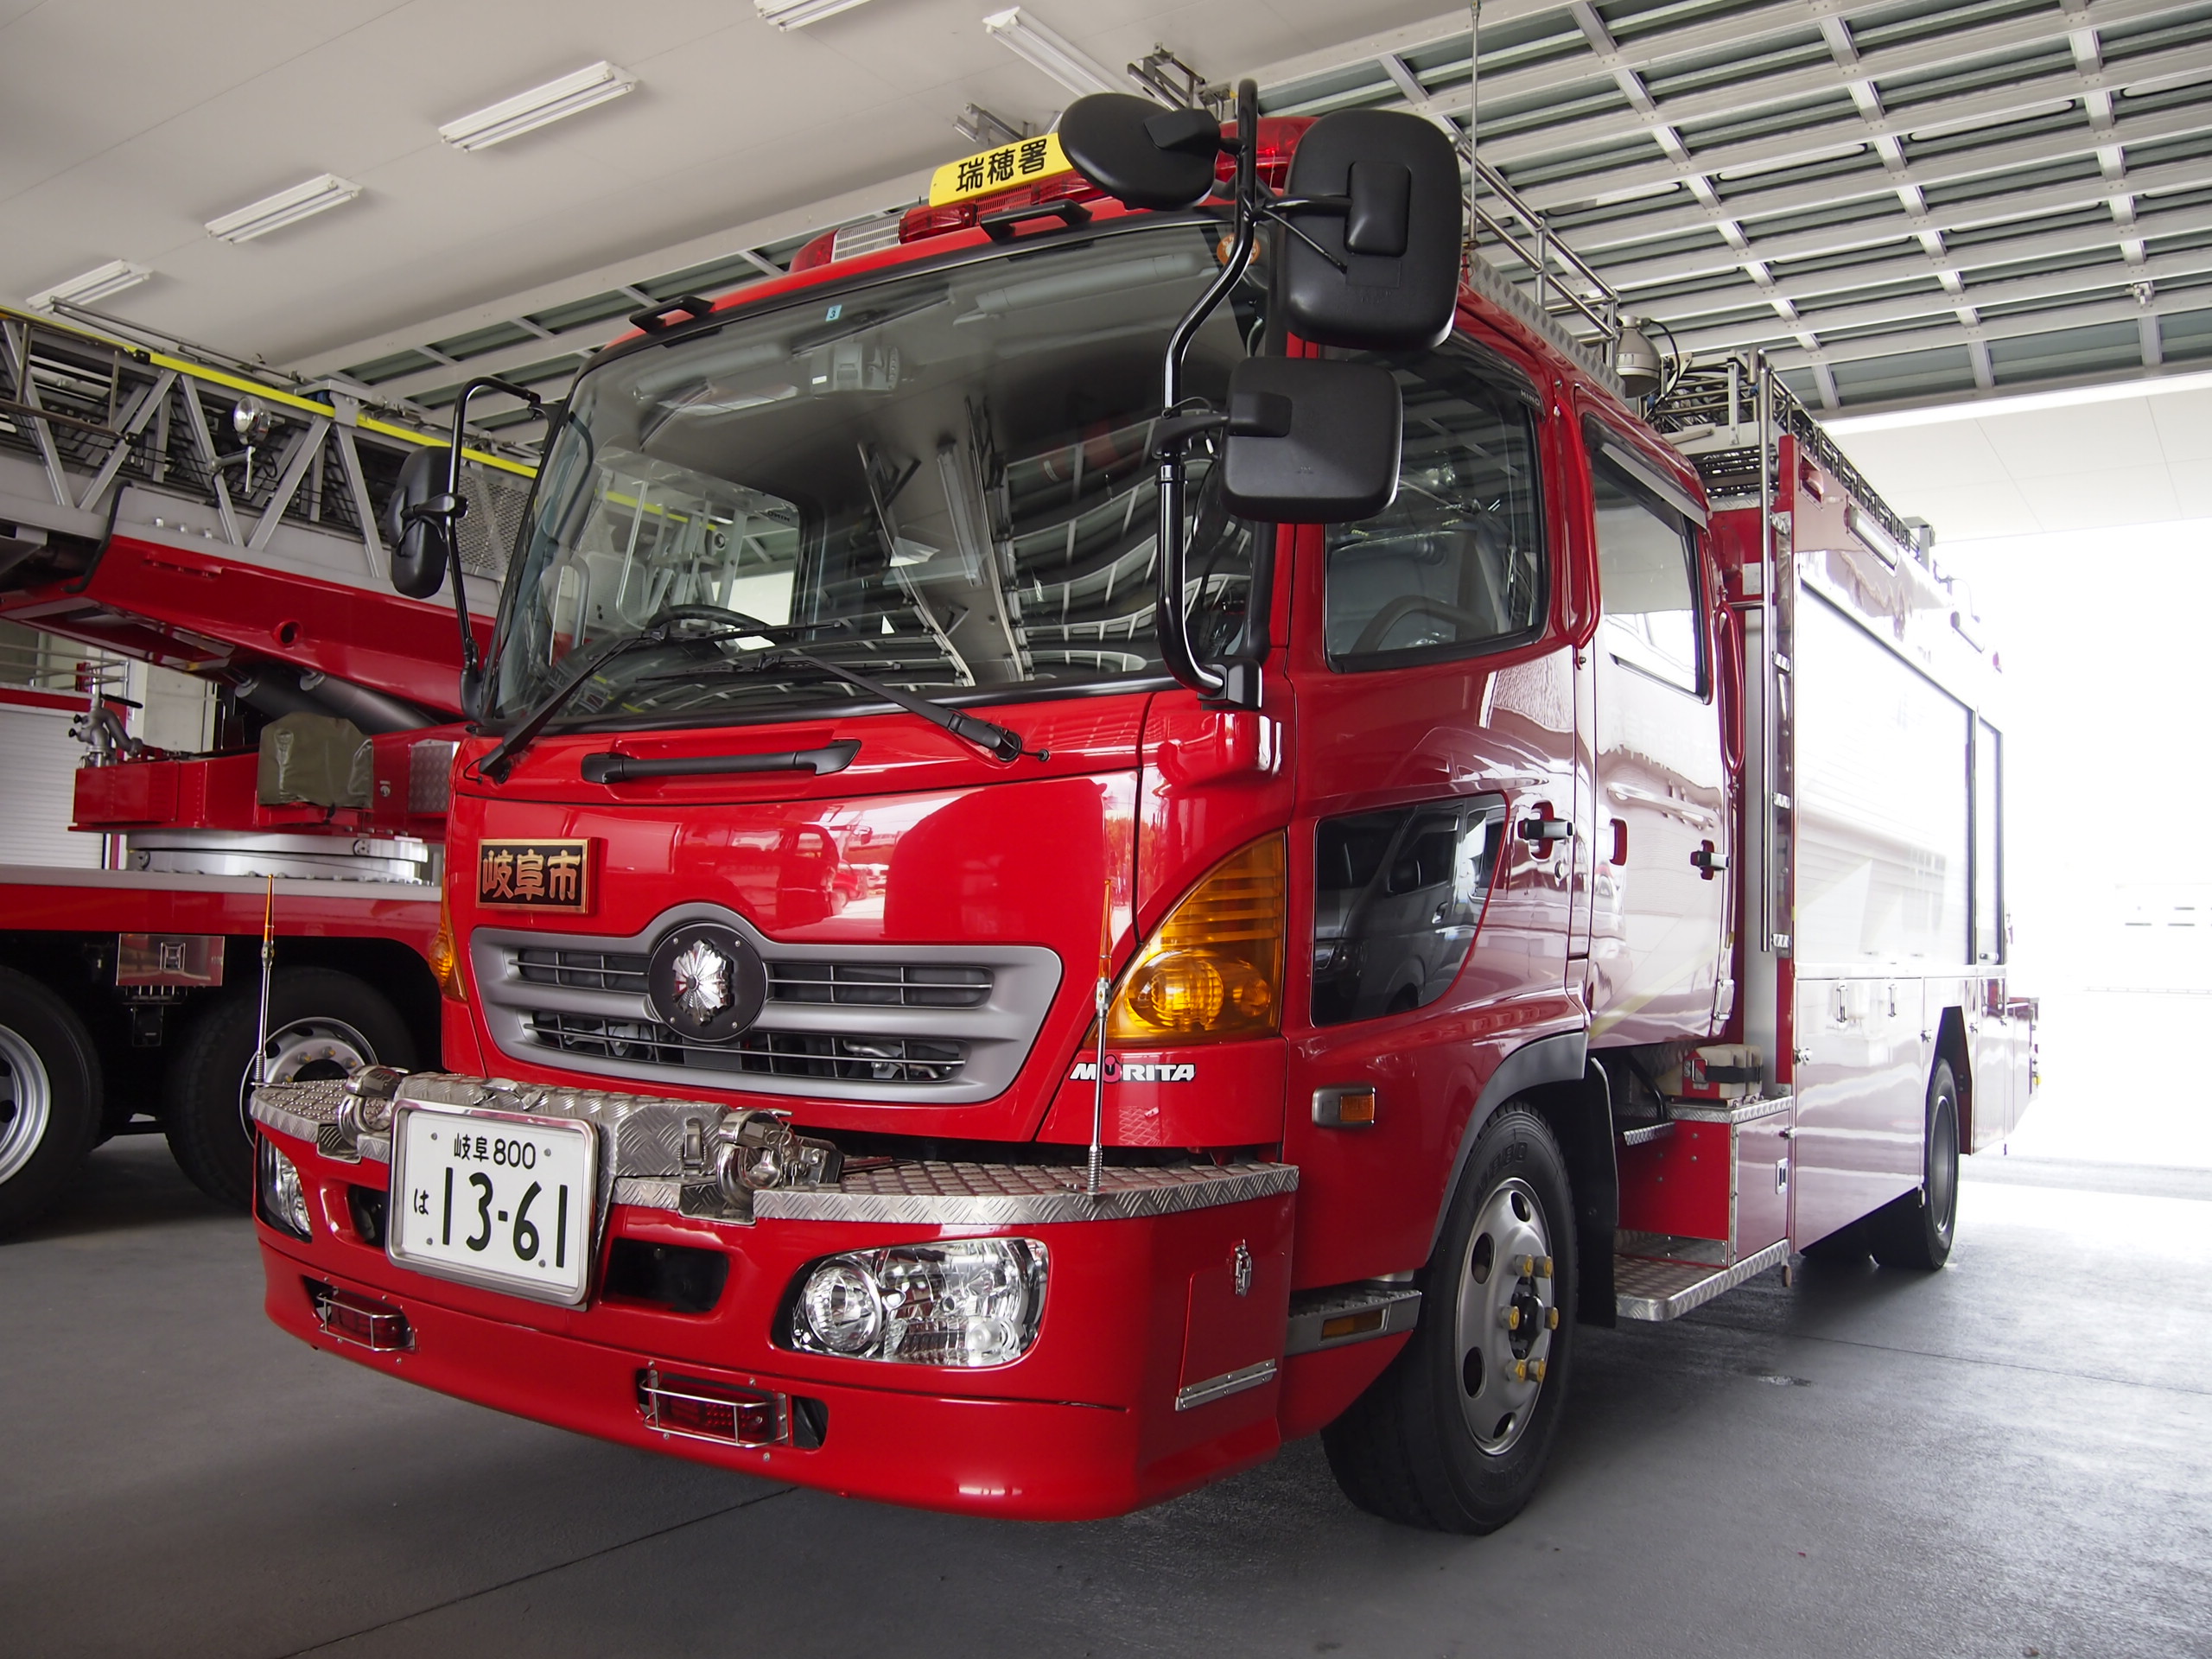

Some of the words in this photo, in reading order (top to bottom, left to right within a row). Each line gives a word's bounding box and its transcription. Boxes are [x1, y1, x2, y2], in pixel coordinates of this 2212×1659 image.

[956, 138, 1047, 192] 瑞穂署
[1521, 389, 1541, 407] HINO
[481, 849, 582, 901] 岐阜市
[1069, 1054, 1196, 1084] MORITA
[414, 1188, 429, 1215] は
[442, 1167, 568, 1268] 13-61
